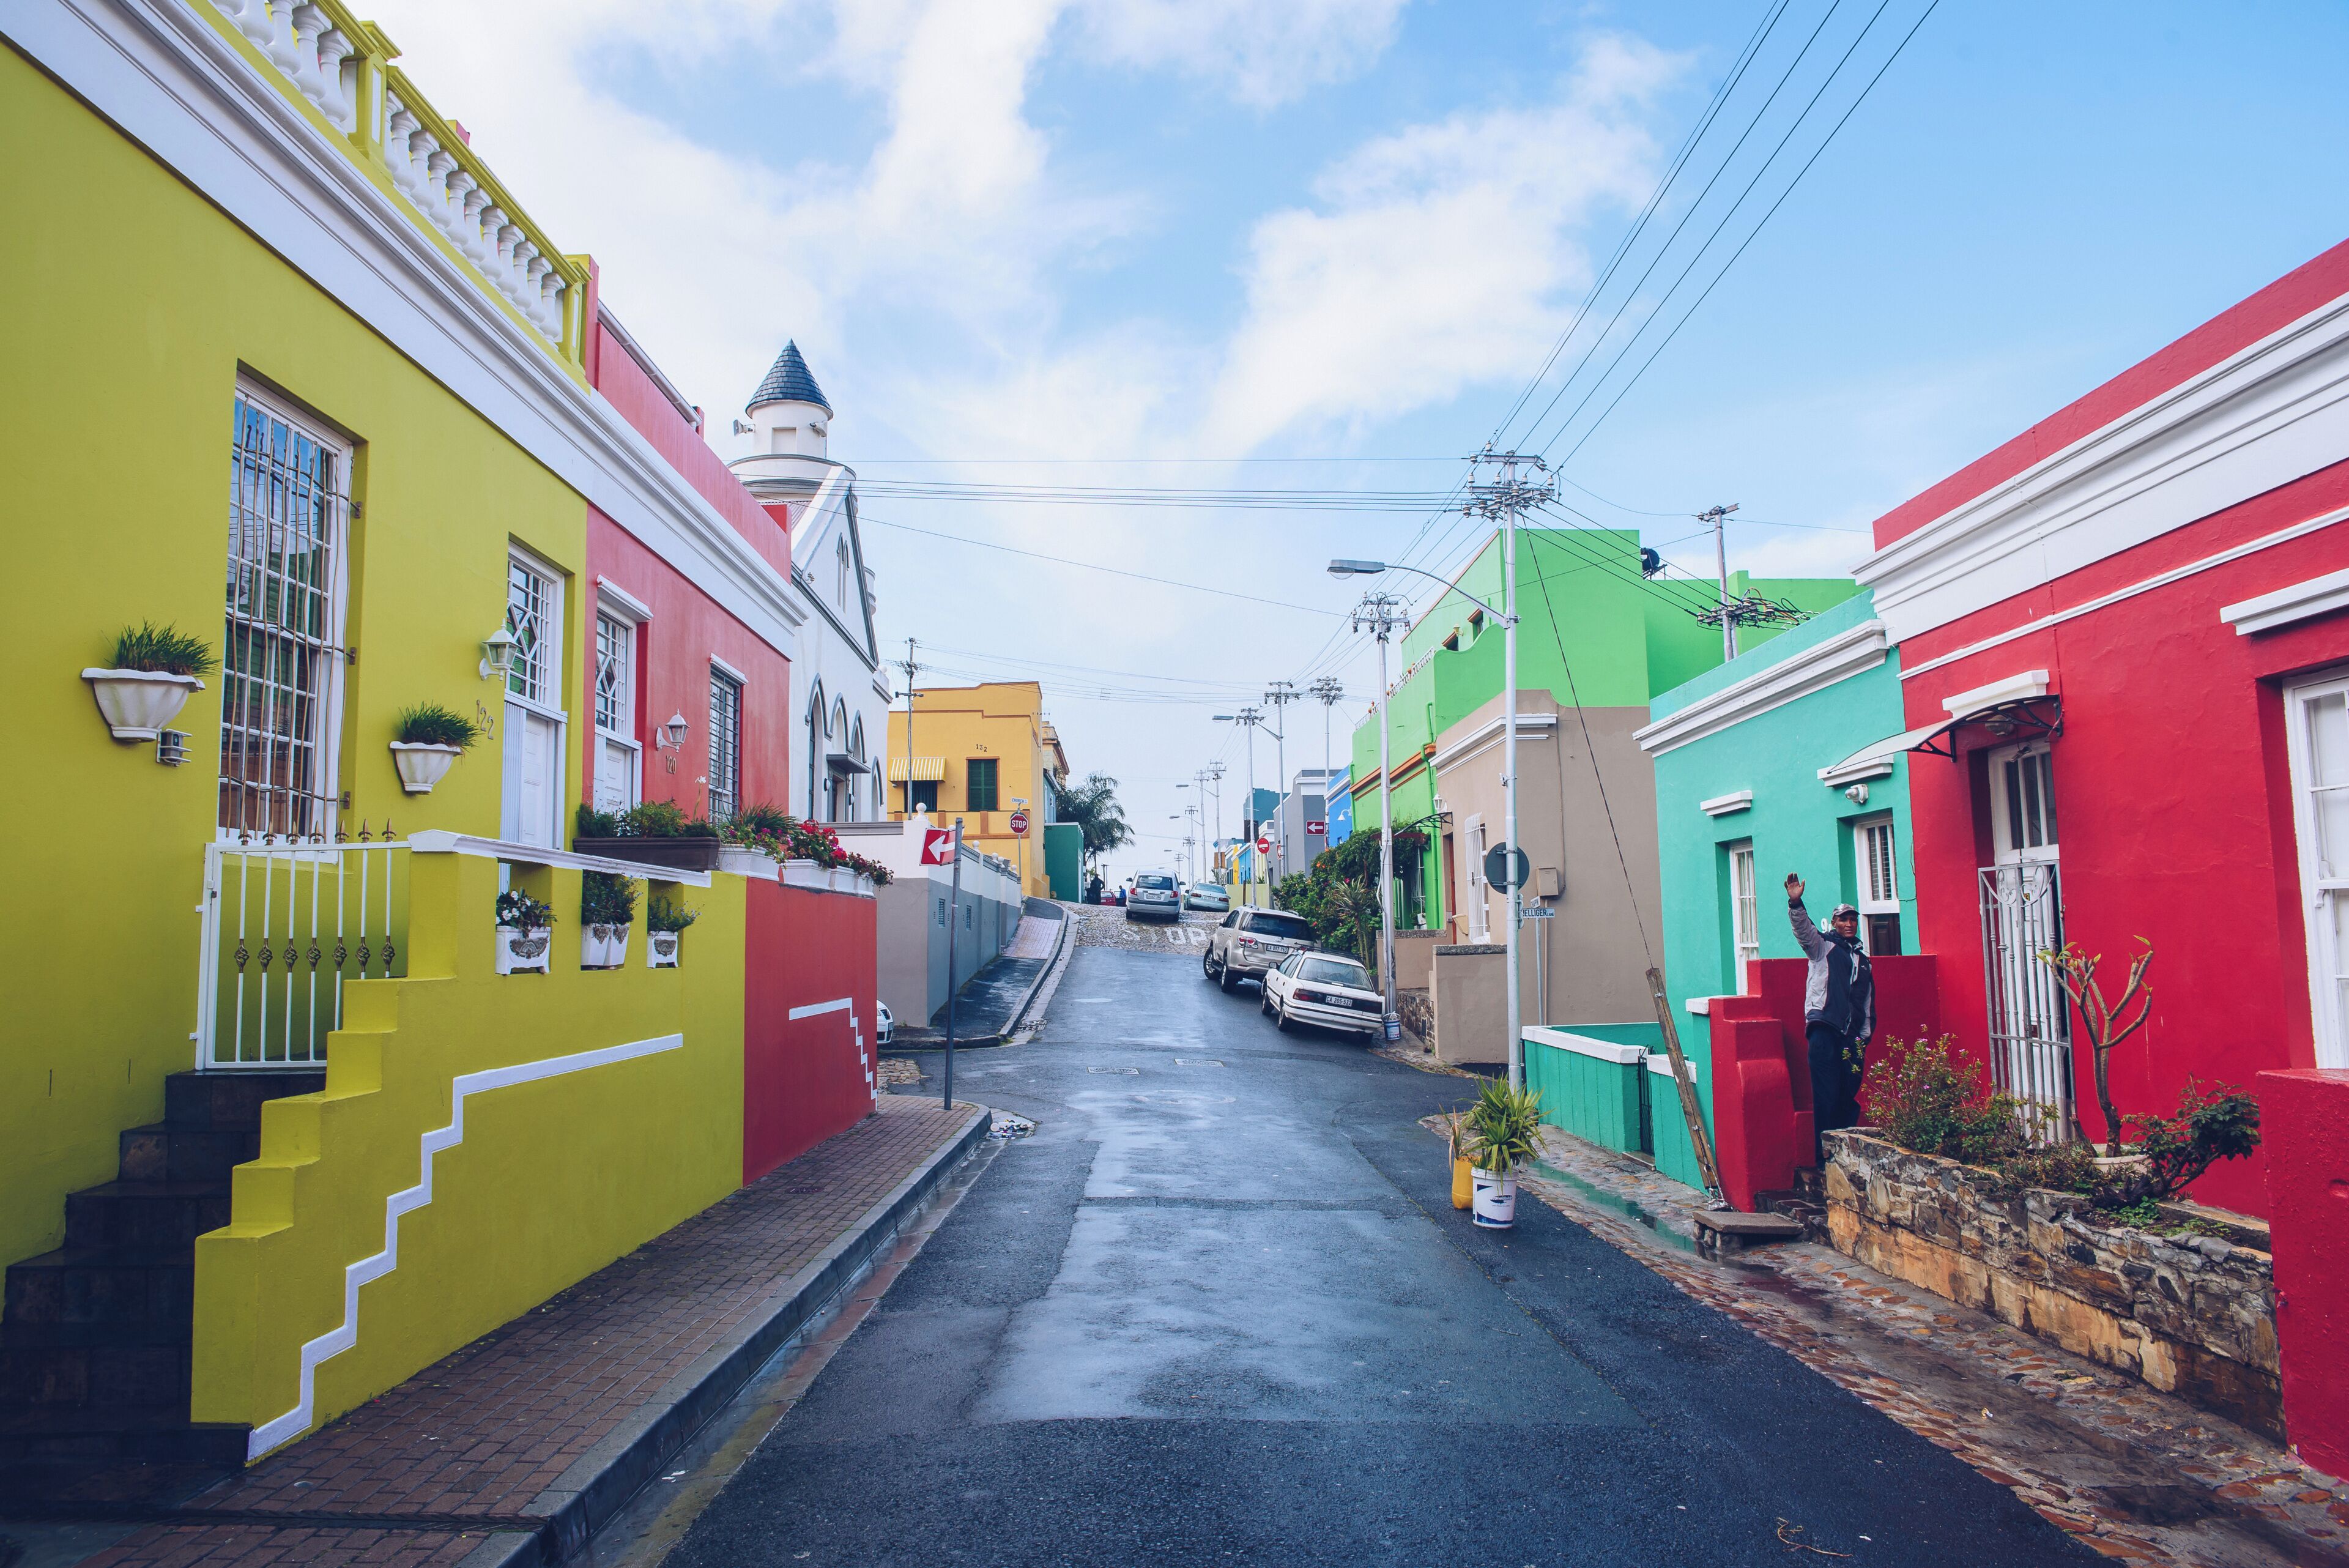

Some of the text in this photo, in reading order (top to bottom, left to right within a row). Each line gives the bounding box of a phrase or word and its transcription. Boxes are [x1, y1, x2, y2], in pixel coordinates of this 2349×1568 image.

[477, 699, 494, 740] 122
[976, 743, 987, 752] 132
[666, 755, 677, 775] 120
[1011, 820, 1026, 828] STOP
